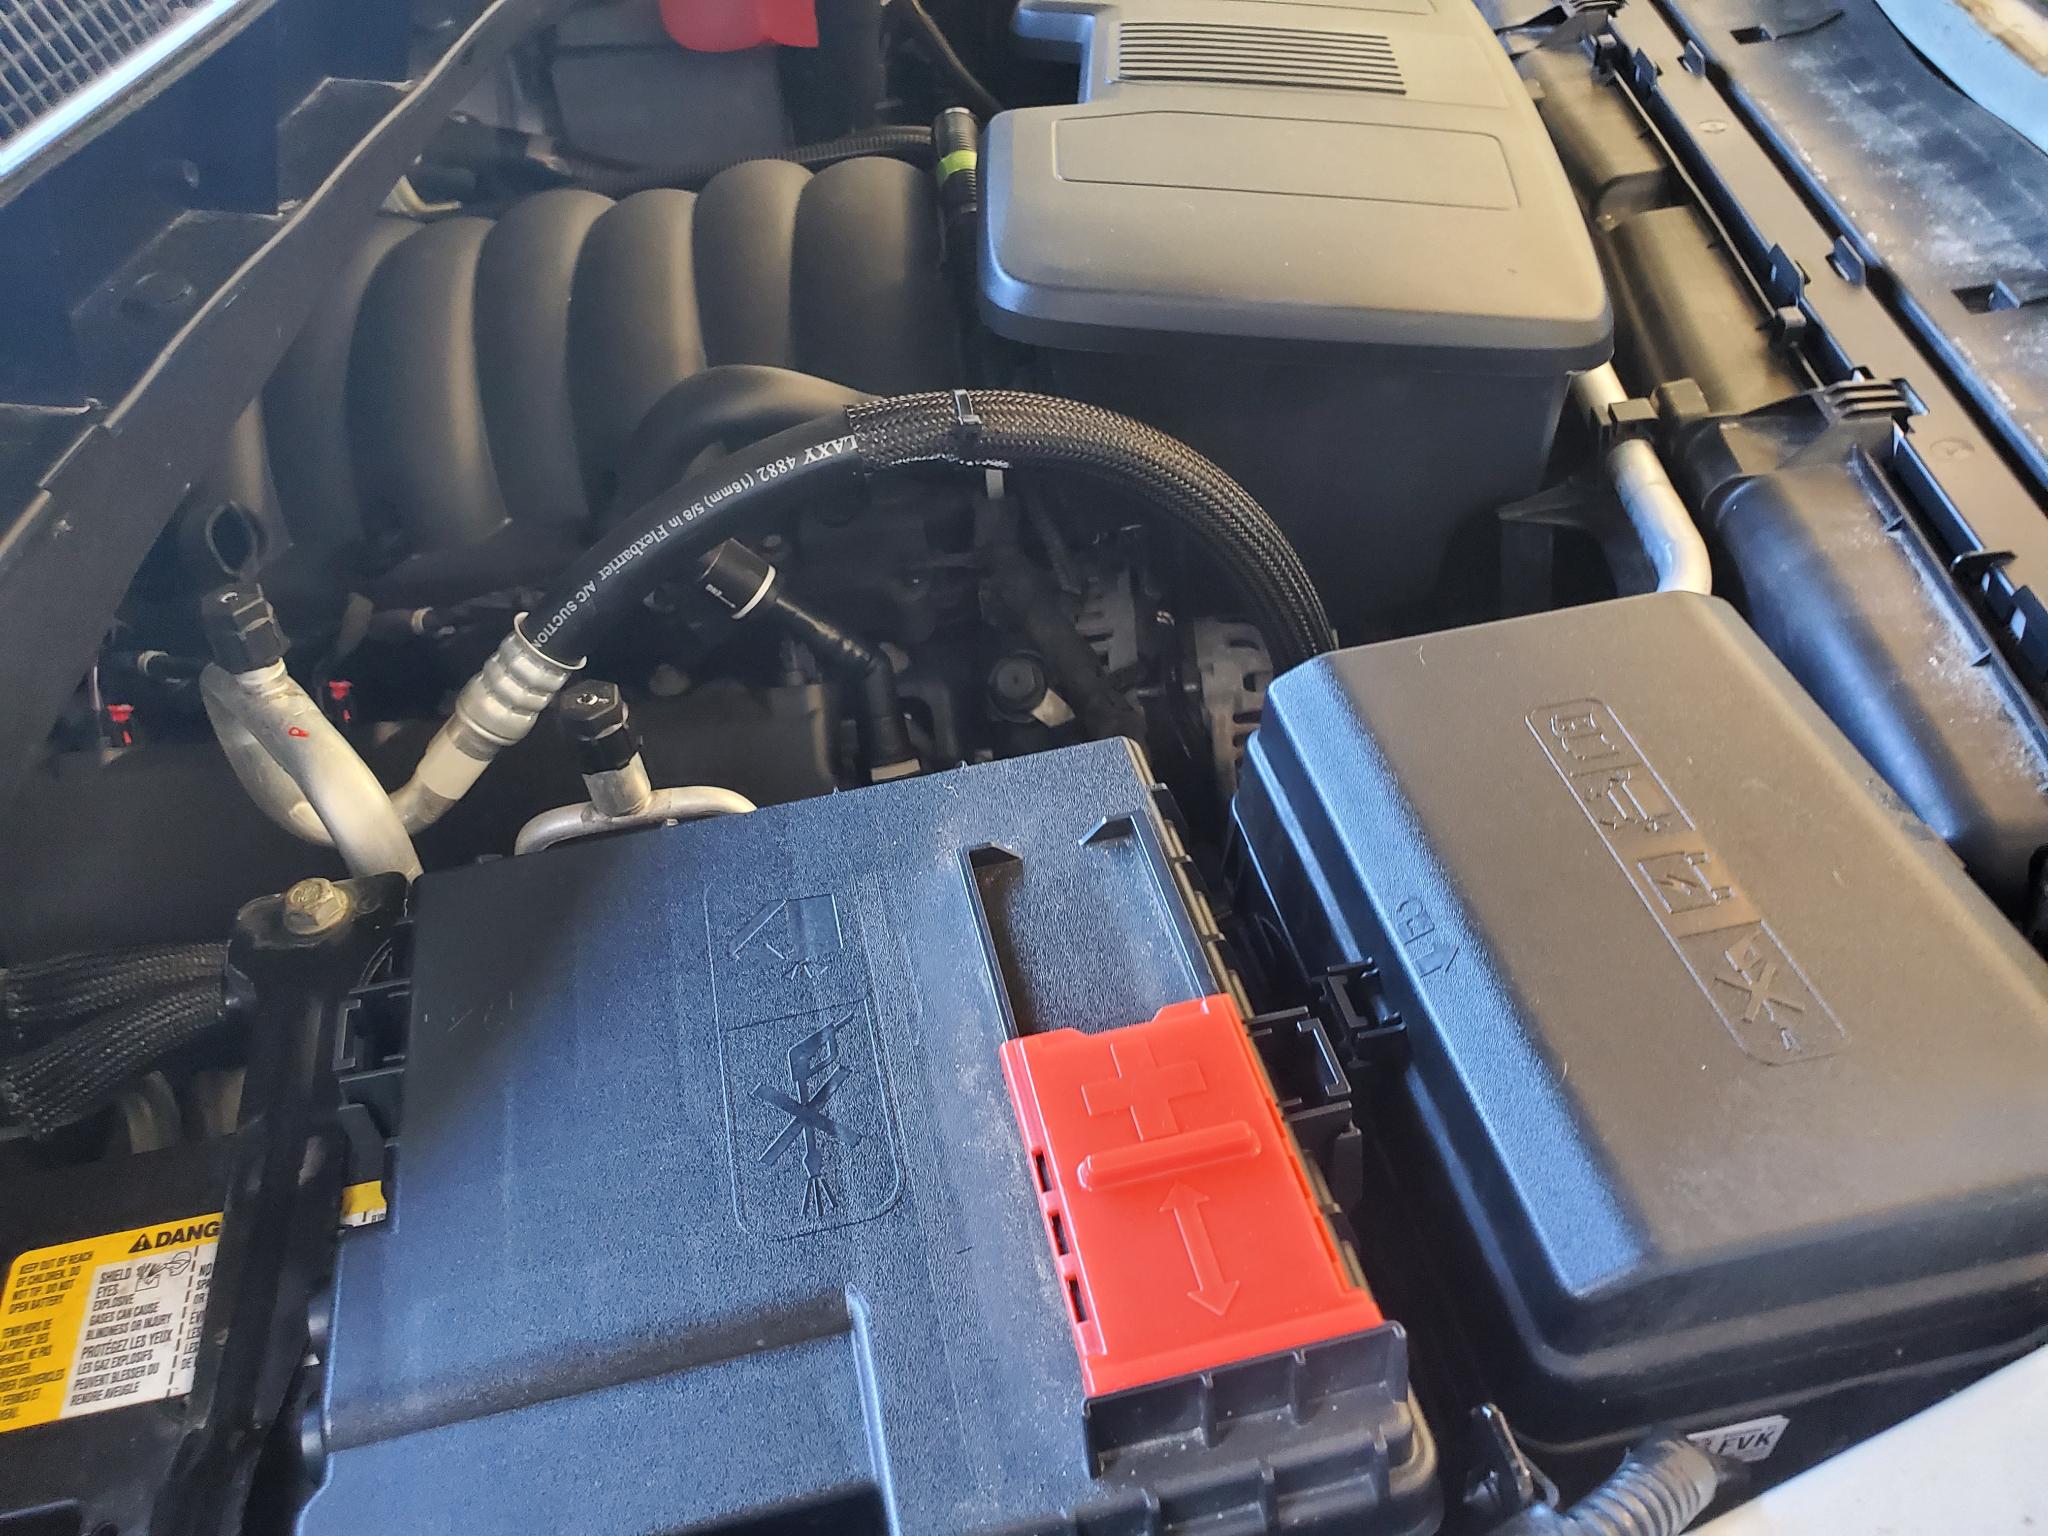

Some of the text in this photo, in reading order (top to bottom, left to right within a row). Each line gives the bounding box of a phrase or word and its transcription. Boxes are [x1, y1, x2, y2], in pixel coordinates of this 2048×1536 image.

[803, 434, 860, 465] LAXY
[756, 456, 797, 483] 4882
[703, 473, 756, 509] (16mm)
[682, 502, 706, 522] 5/8
[597, 524, 670, 582] Flexbarrier
[575, 581, 597, 605] A/C
[534, 600, 579, 649] SUCTION
[154, 1221, 221, 1248] DANG
[69, 1251, 95, 1264] REACH
[100, 1268, 132, 1284] SHIELD
[93, 1294, 135, 1312] EXPLOSIVE
[96, 1284, 119, 1299] EYES
[85, 1313, 173, 1341] BLINDNESS OR INJURY
[89, 1302, 160, 1326] GASES CAN CAUSE
[80, 1330, 174, 1360] PROTÉGEZ LES YEUX
[77, 1349, 154, 1375] LES GAZ EXPLOSIFS
[73, 1362, 160, 1391] PEUVENT BLESSER OU
[70, 1382, 141, 1406] RENDRE AVEUGLE
